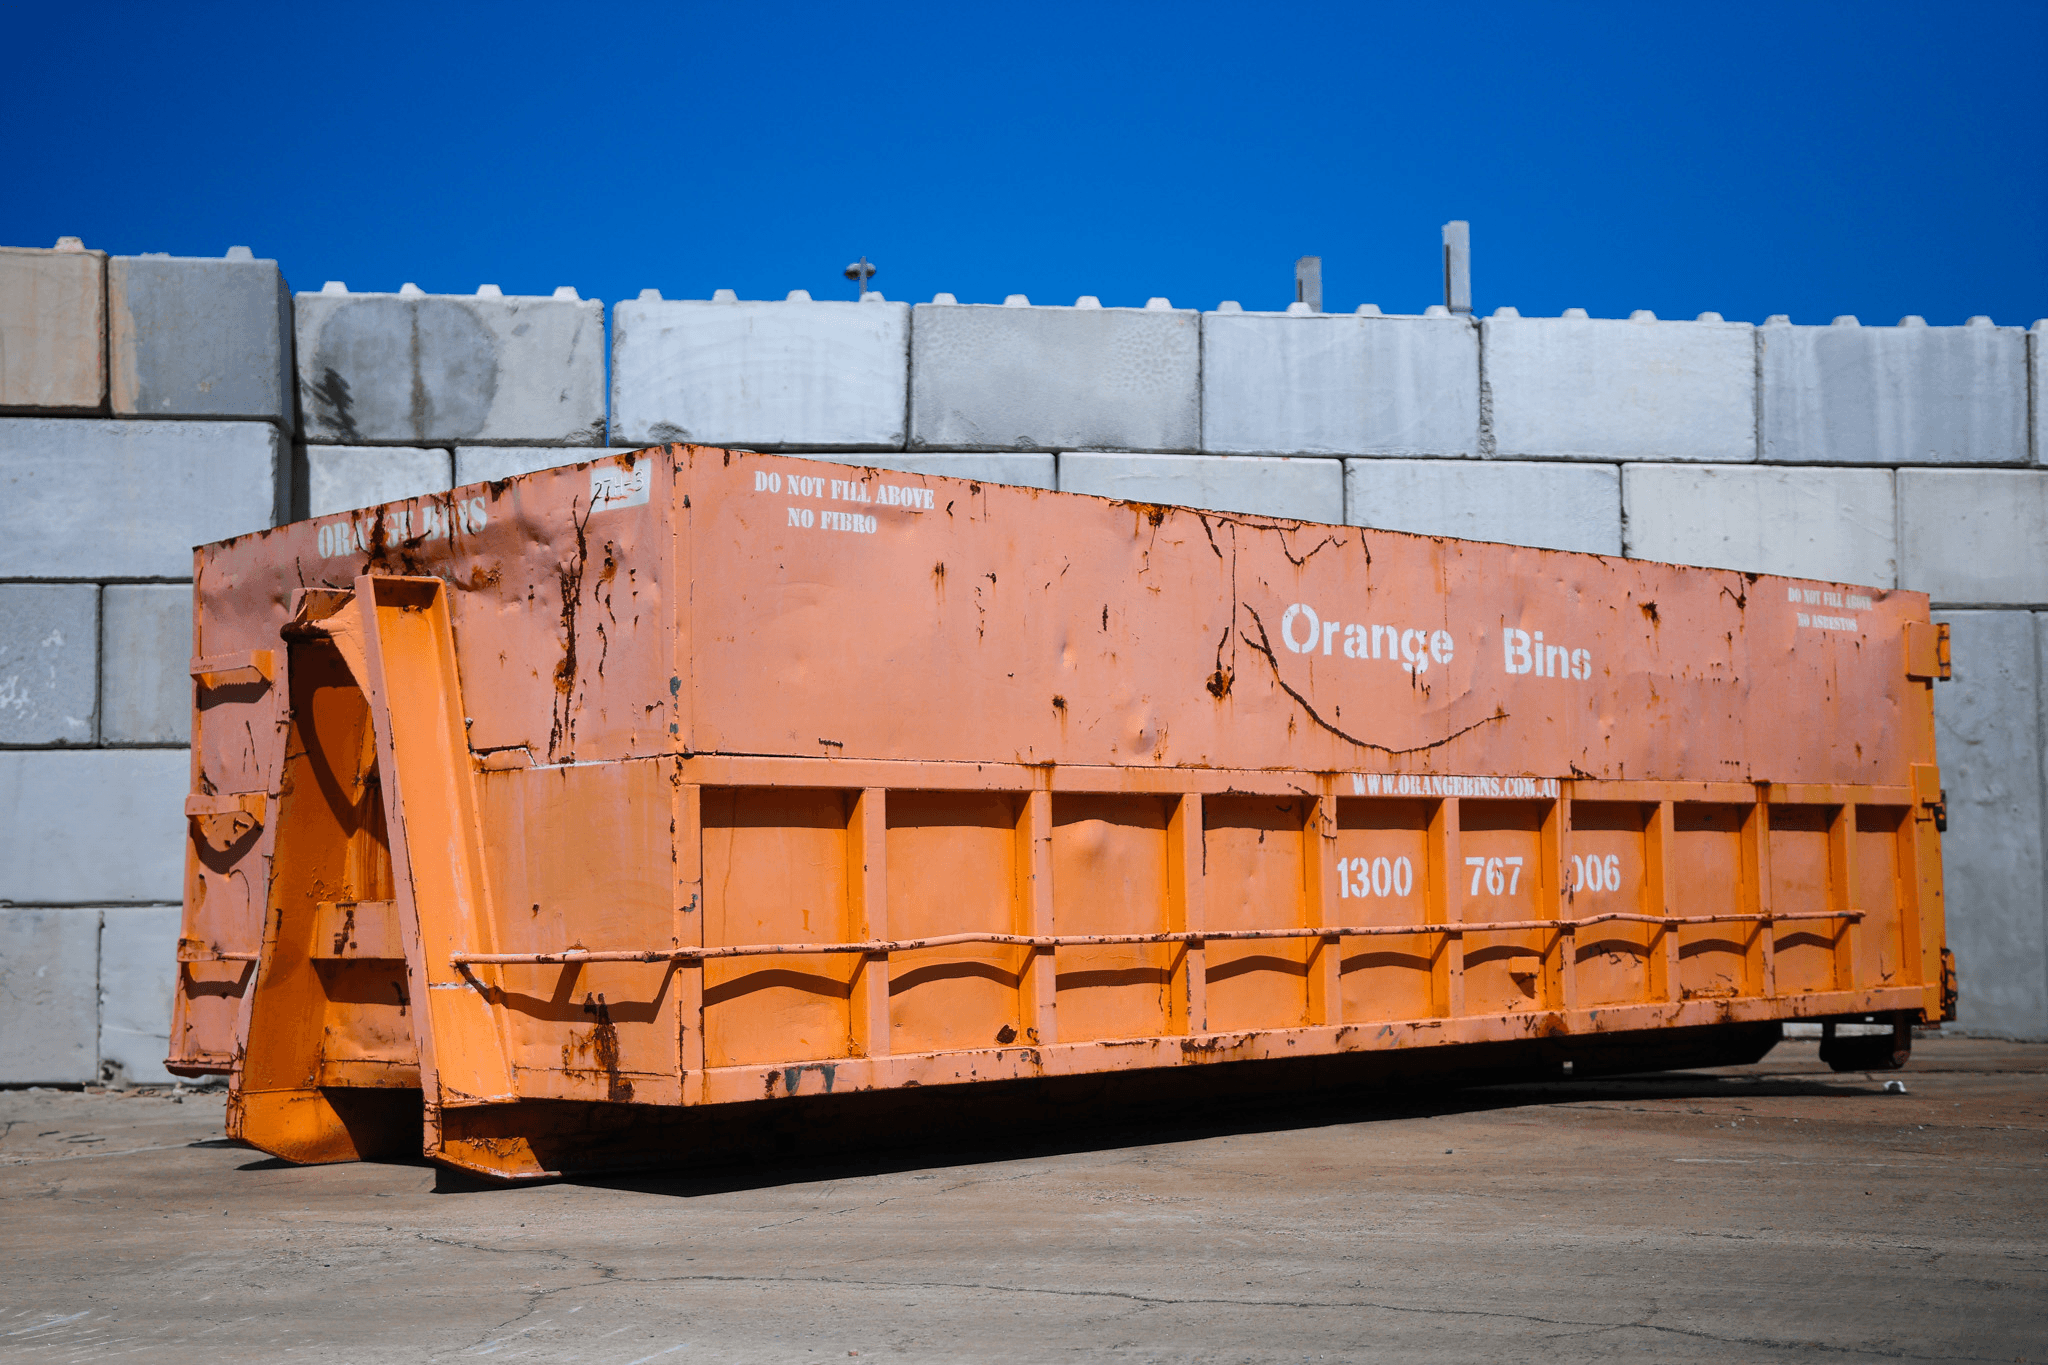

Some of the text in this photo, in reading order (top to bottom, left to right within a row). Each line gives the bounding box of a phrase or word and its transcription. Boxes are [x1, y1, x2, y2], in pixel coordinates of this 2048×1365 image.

[754, 471, 935, 510] DO NOT FILL ABOVE
[787, 507, 877, 534] NO FIBRO
[1788, 587, 1802, 602] DO
[1804, 589, 1821, 605] NOT
[1823, 592, 1843, 608] FILL
[1797, 613, 1810, 627] NO
[1282, 603, 1592, 680] Orange Bins
[1353, 773, 1560, 798] WWW.ORANGEBINS.COM.AU
[1337, 856, 1413, 898] 1300
[1465, 856, 1523, 896] 767
